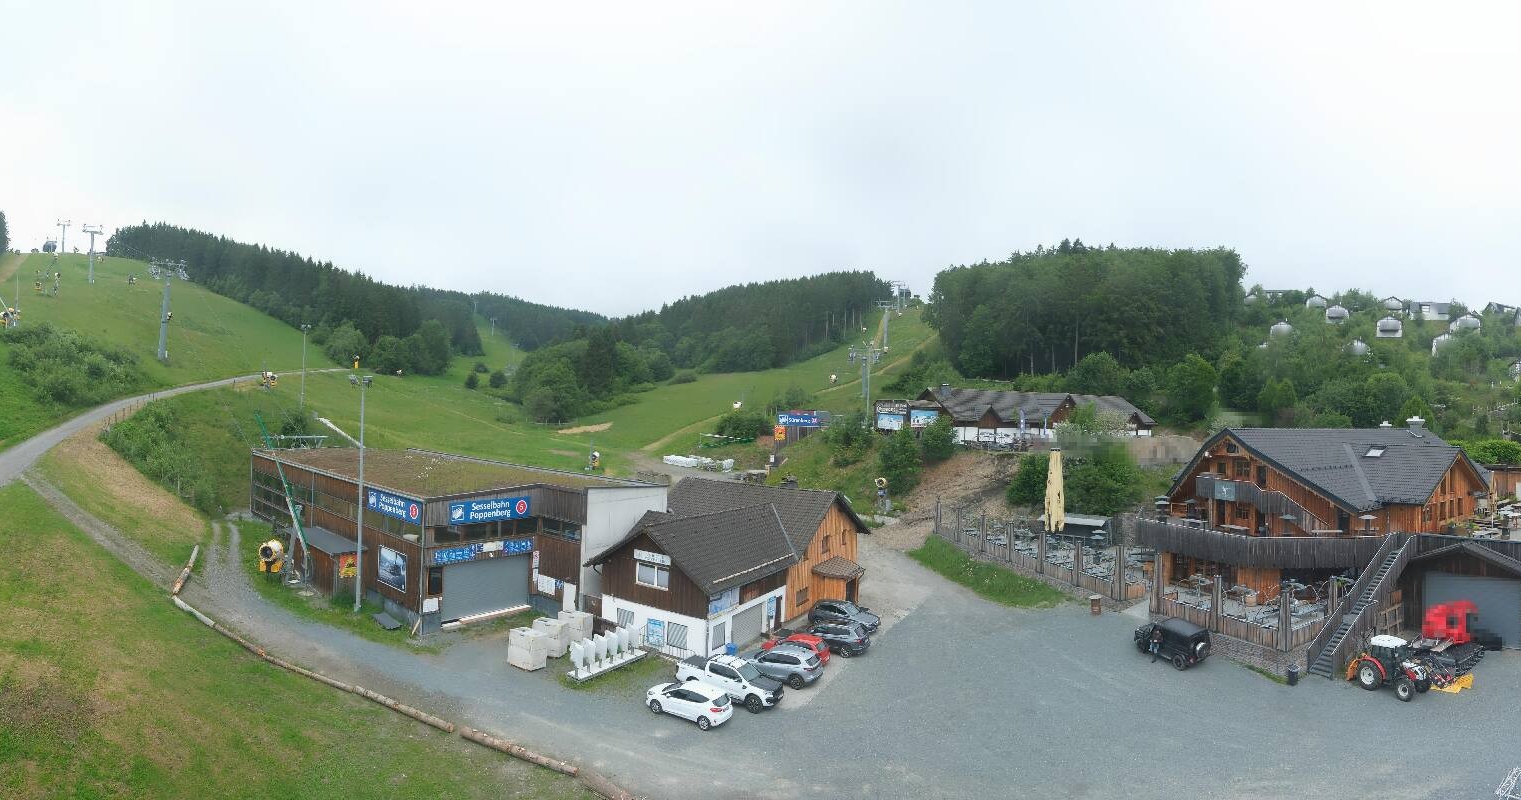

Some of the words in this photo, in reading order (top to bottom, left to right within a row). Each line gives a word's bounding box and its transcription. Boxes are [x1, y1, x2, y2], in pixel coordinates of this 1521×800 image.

[380, 494, 406, 507] Sesselbahn
[472, 500, 510, 511] Sesselbahn
[378, 502, 406, 518] Poppenberg
[470, 509, 511, 521] Poppenberg
